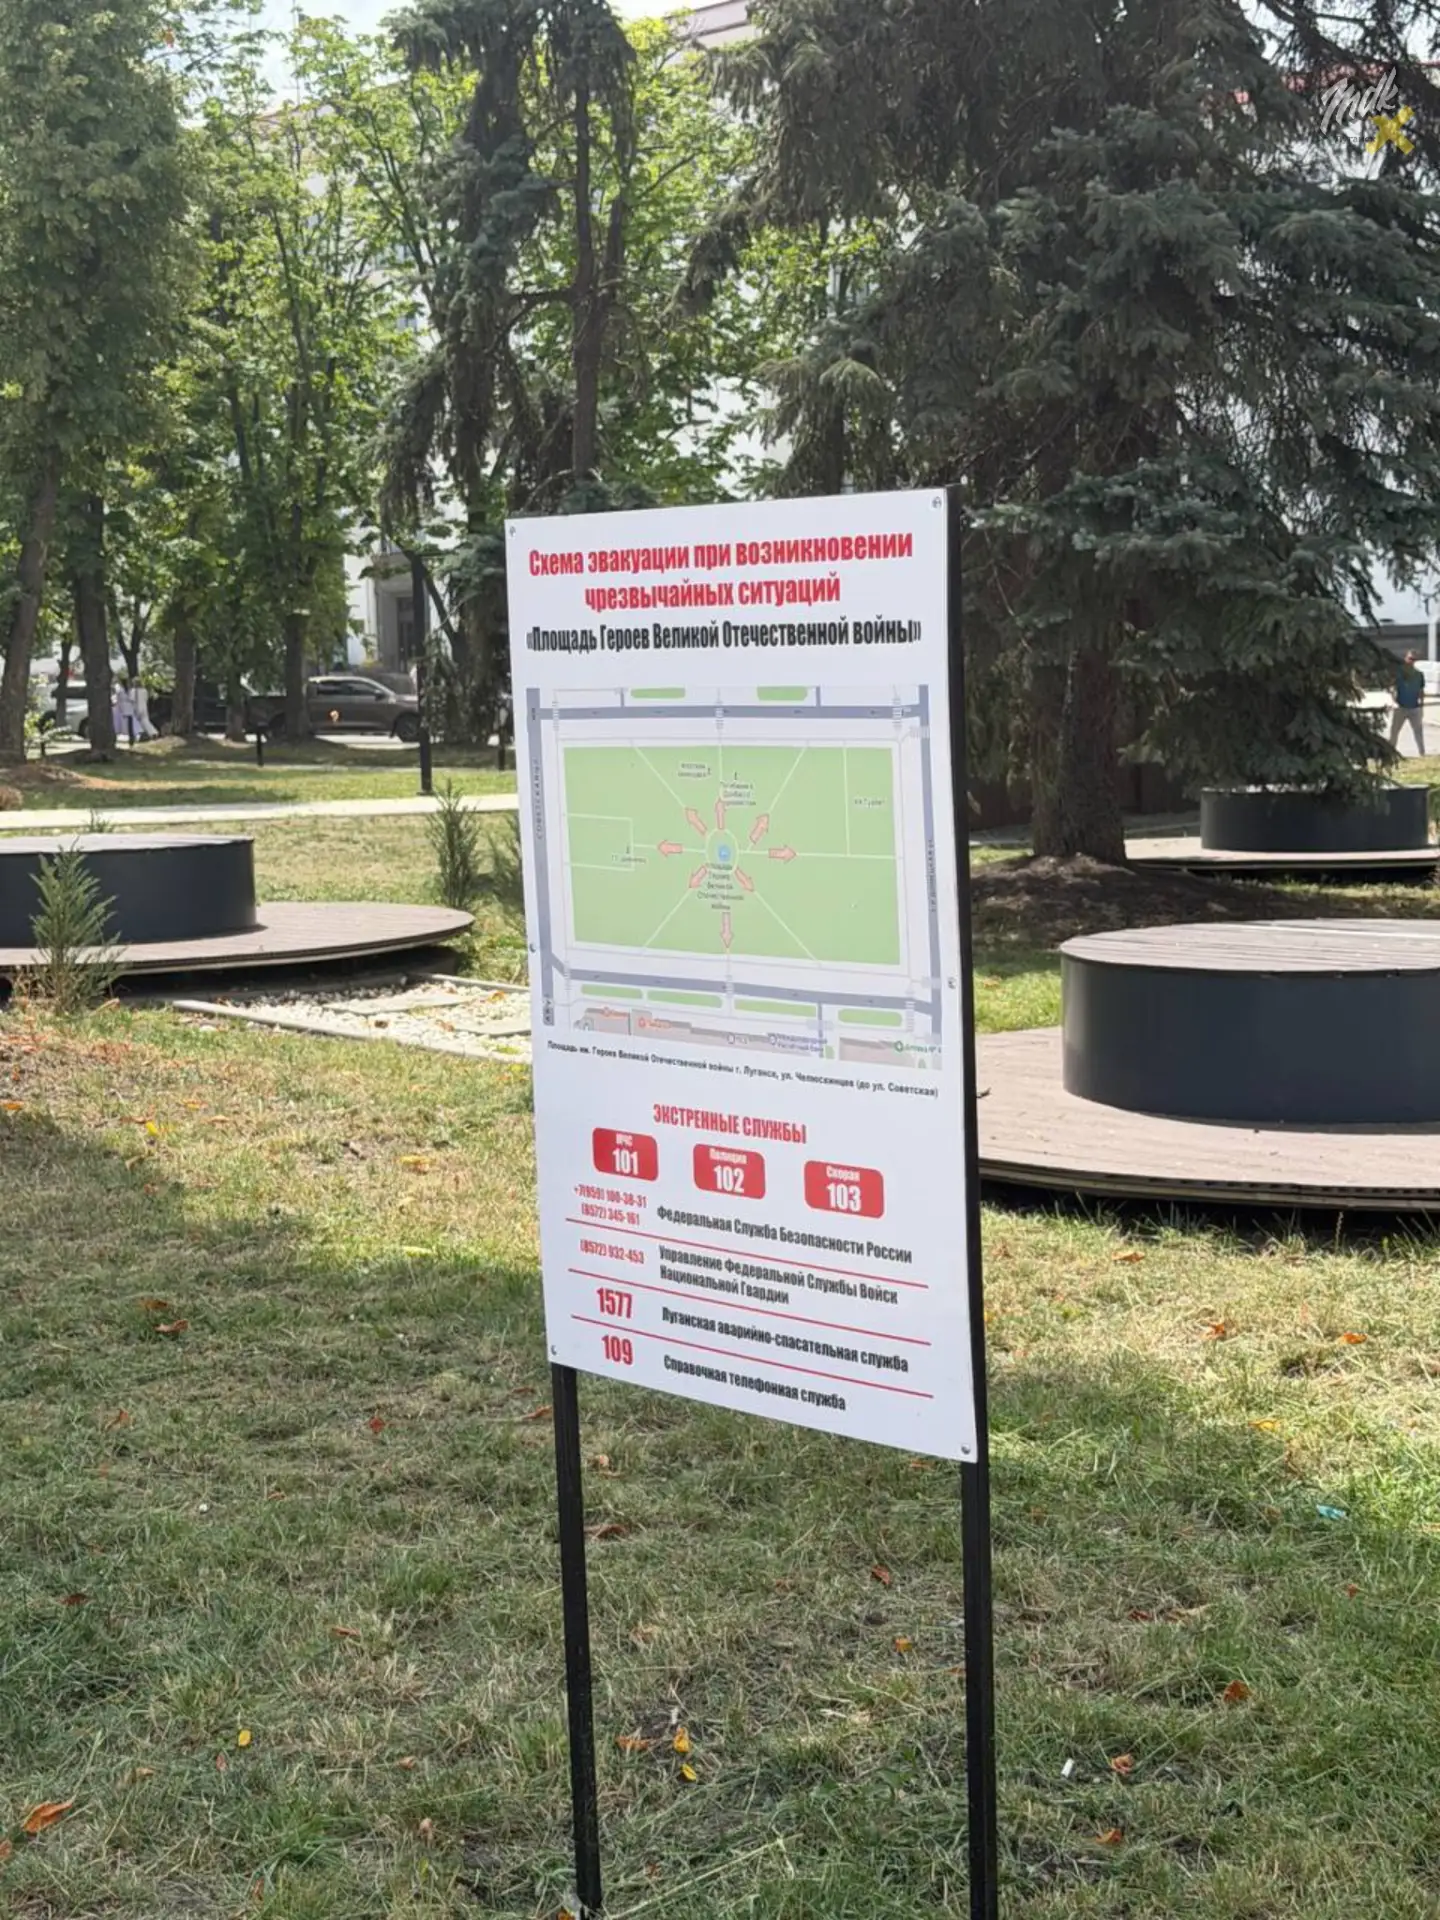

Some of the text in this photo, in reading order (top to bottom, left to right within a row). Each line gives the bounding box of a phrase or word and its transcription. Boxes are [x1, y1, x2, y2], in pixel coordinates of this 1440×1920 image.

[529, 533, 913, 576] Схема эвакуации при возникновении
[585, 572, 841, 613] чрезвычайных ситуаций
[526, 614, 922, 653] «Площадь Героев Великой Отечественной войны»
[592, 1046, 617, 1059] Героев
[618, 1049, 649, 1062] Великой
[651, 1054, 706, 1070] Отечественной
[709, 1060, 734, 1073] войны
[856, 1079, 870, 1092] (до
[872, 1082, 885, 1093] ул.
[887, 1082, 939, 1100] Советская)
[653, 1103, 807, 1145] ЭКСТРЕННЫЕ СЛУЖБЫ
[612, 1147, 639, 1176] 101
[713, 1165, 745, 1194] 102
[826, 1165, 860, 1182] Скорая
[826, 1182, 861, 1212] 103
[657, 1206, 912, 1264] Федеральная Служба Безопасности России
[659, 1245, 898, 1305] Управление Федеральной Службы Войск
[660, 1265, 789, 1306] Национальной Гвардии
[597, 1287, 633, 1319] 1577
[602, 1334, 634, 1366] 109
[661, 1306, 909, 1373] Луганская аварийно-спасательная служба
[663, 1354, 847, 1411] Справочная телефонная служба
